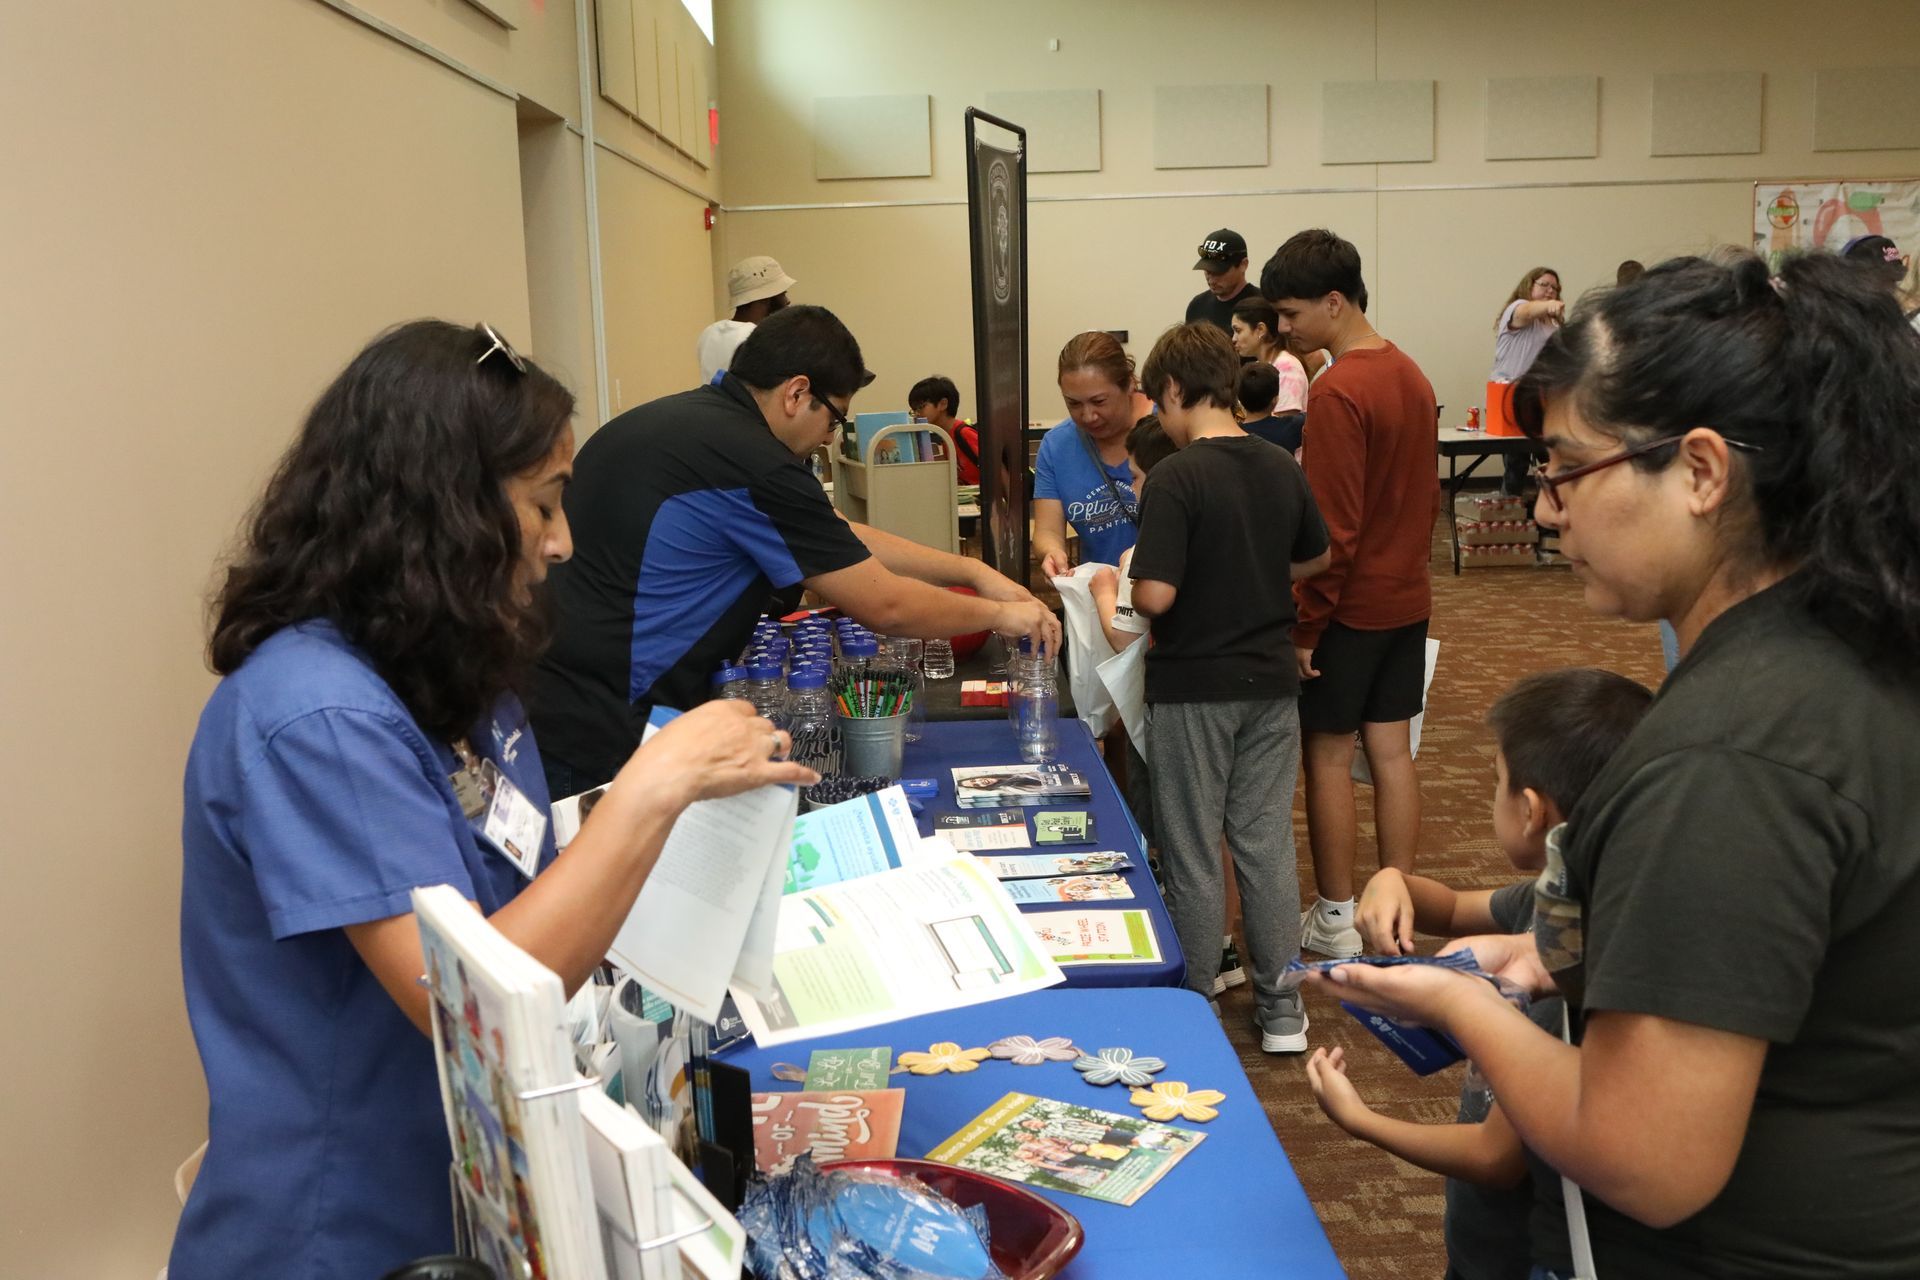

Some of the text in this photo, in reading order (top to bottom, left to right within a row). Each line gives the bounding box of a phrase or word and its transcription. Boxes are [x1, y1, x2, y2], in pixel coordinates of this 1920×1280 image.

[1203, 240, 1227, 251] FOX
[1090, 517, 1131, 533] PANTH
[771, 1123, 796, 1141] OF
